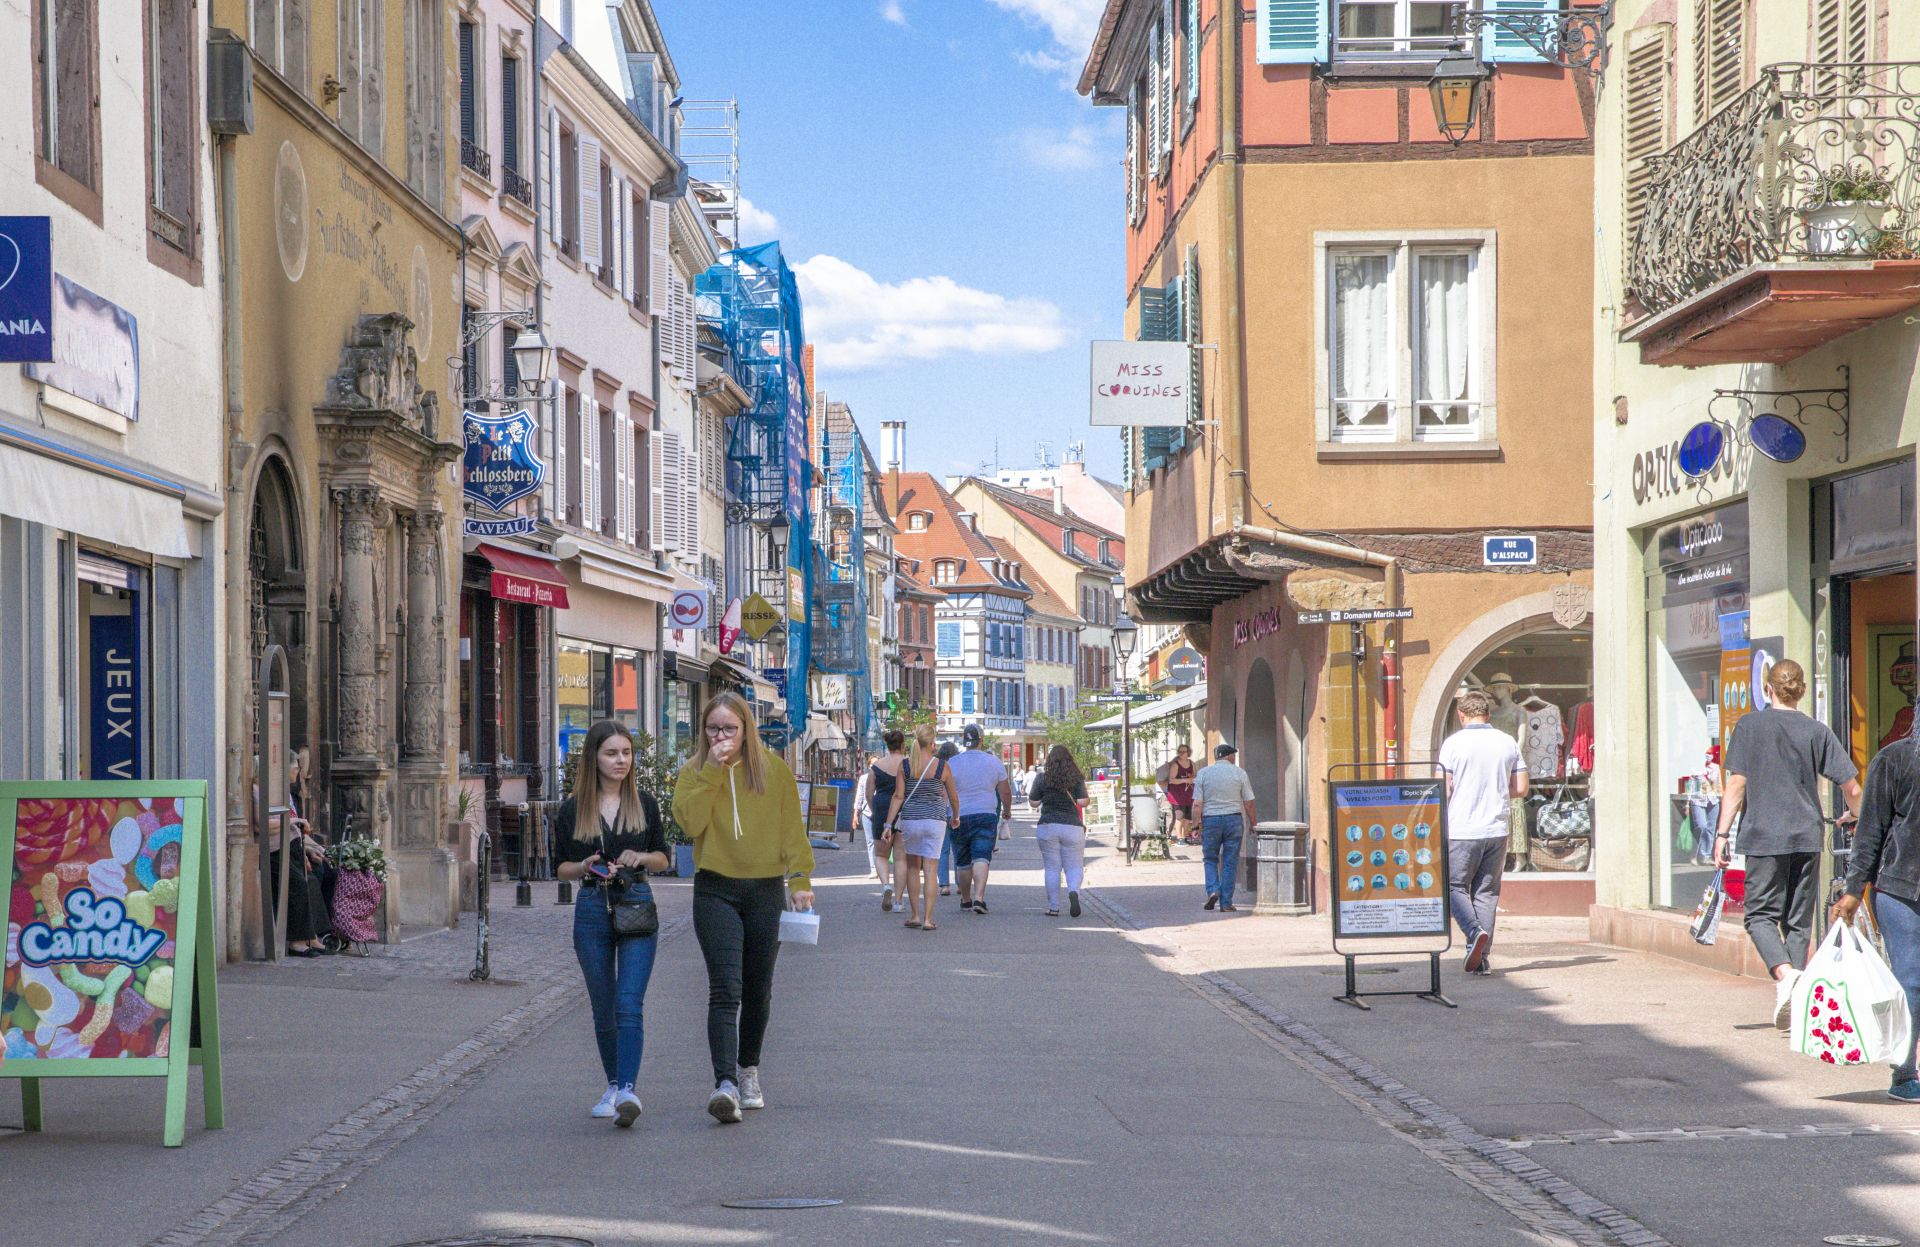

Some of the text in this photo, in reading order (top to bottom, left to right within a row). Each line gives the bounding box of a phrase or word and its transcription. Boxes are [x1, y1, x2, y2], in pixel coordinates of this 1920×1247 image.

[1117, 363, 1163, 377] MISS
[489, 426, 503, 441] Le
[482, 444, 513, 464] Petit
[1632, 440, 1680, 506] OPTIC
[467, 519, 526, 536] CAVEAU
[1492, 551, 1528, 559] D'ALSPACH
[506, 577, 552, 602] Restaurant Pizzeria
[1343, 608, 1412, 620] Domaine Martin Jund
[106, 649, 132, 739] JEUX
[67, 891, 124, 930] So
[21, 921, 162, 962] Candy
